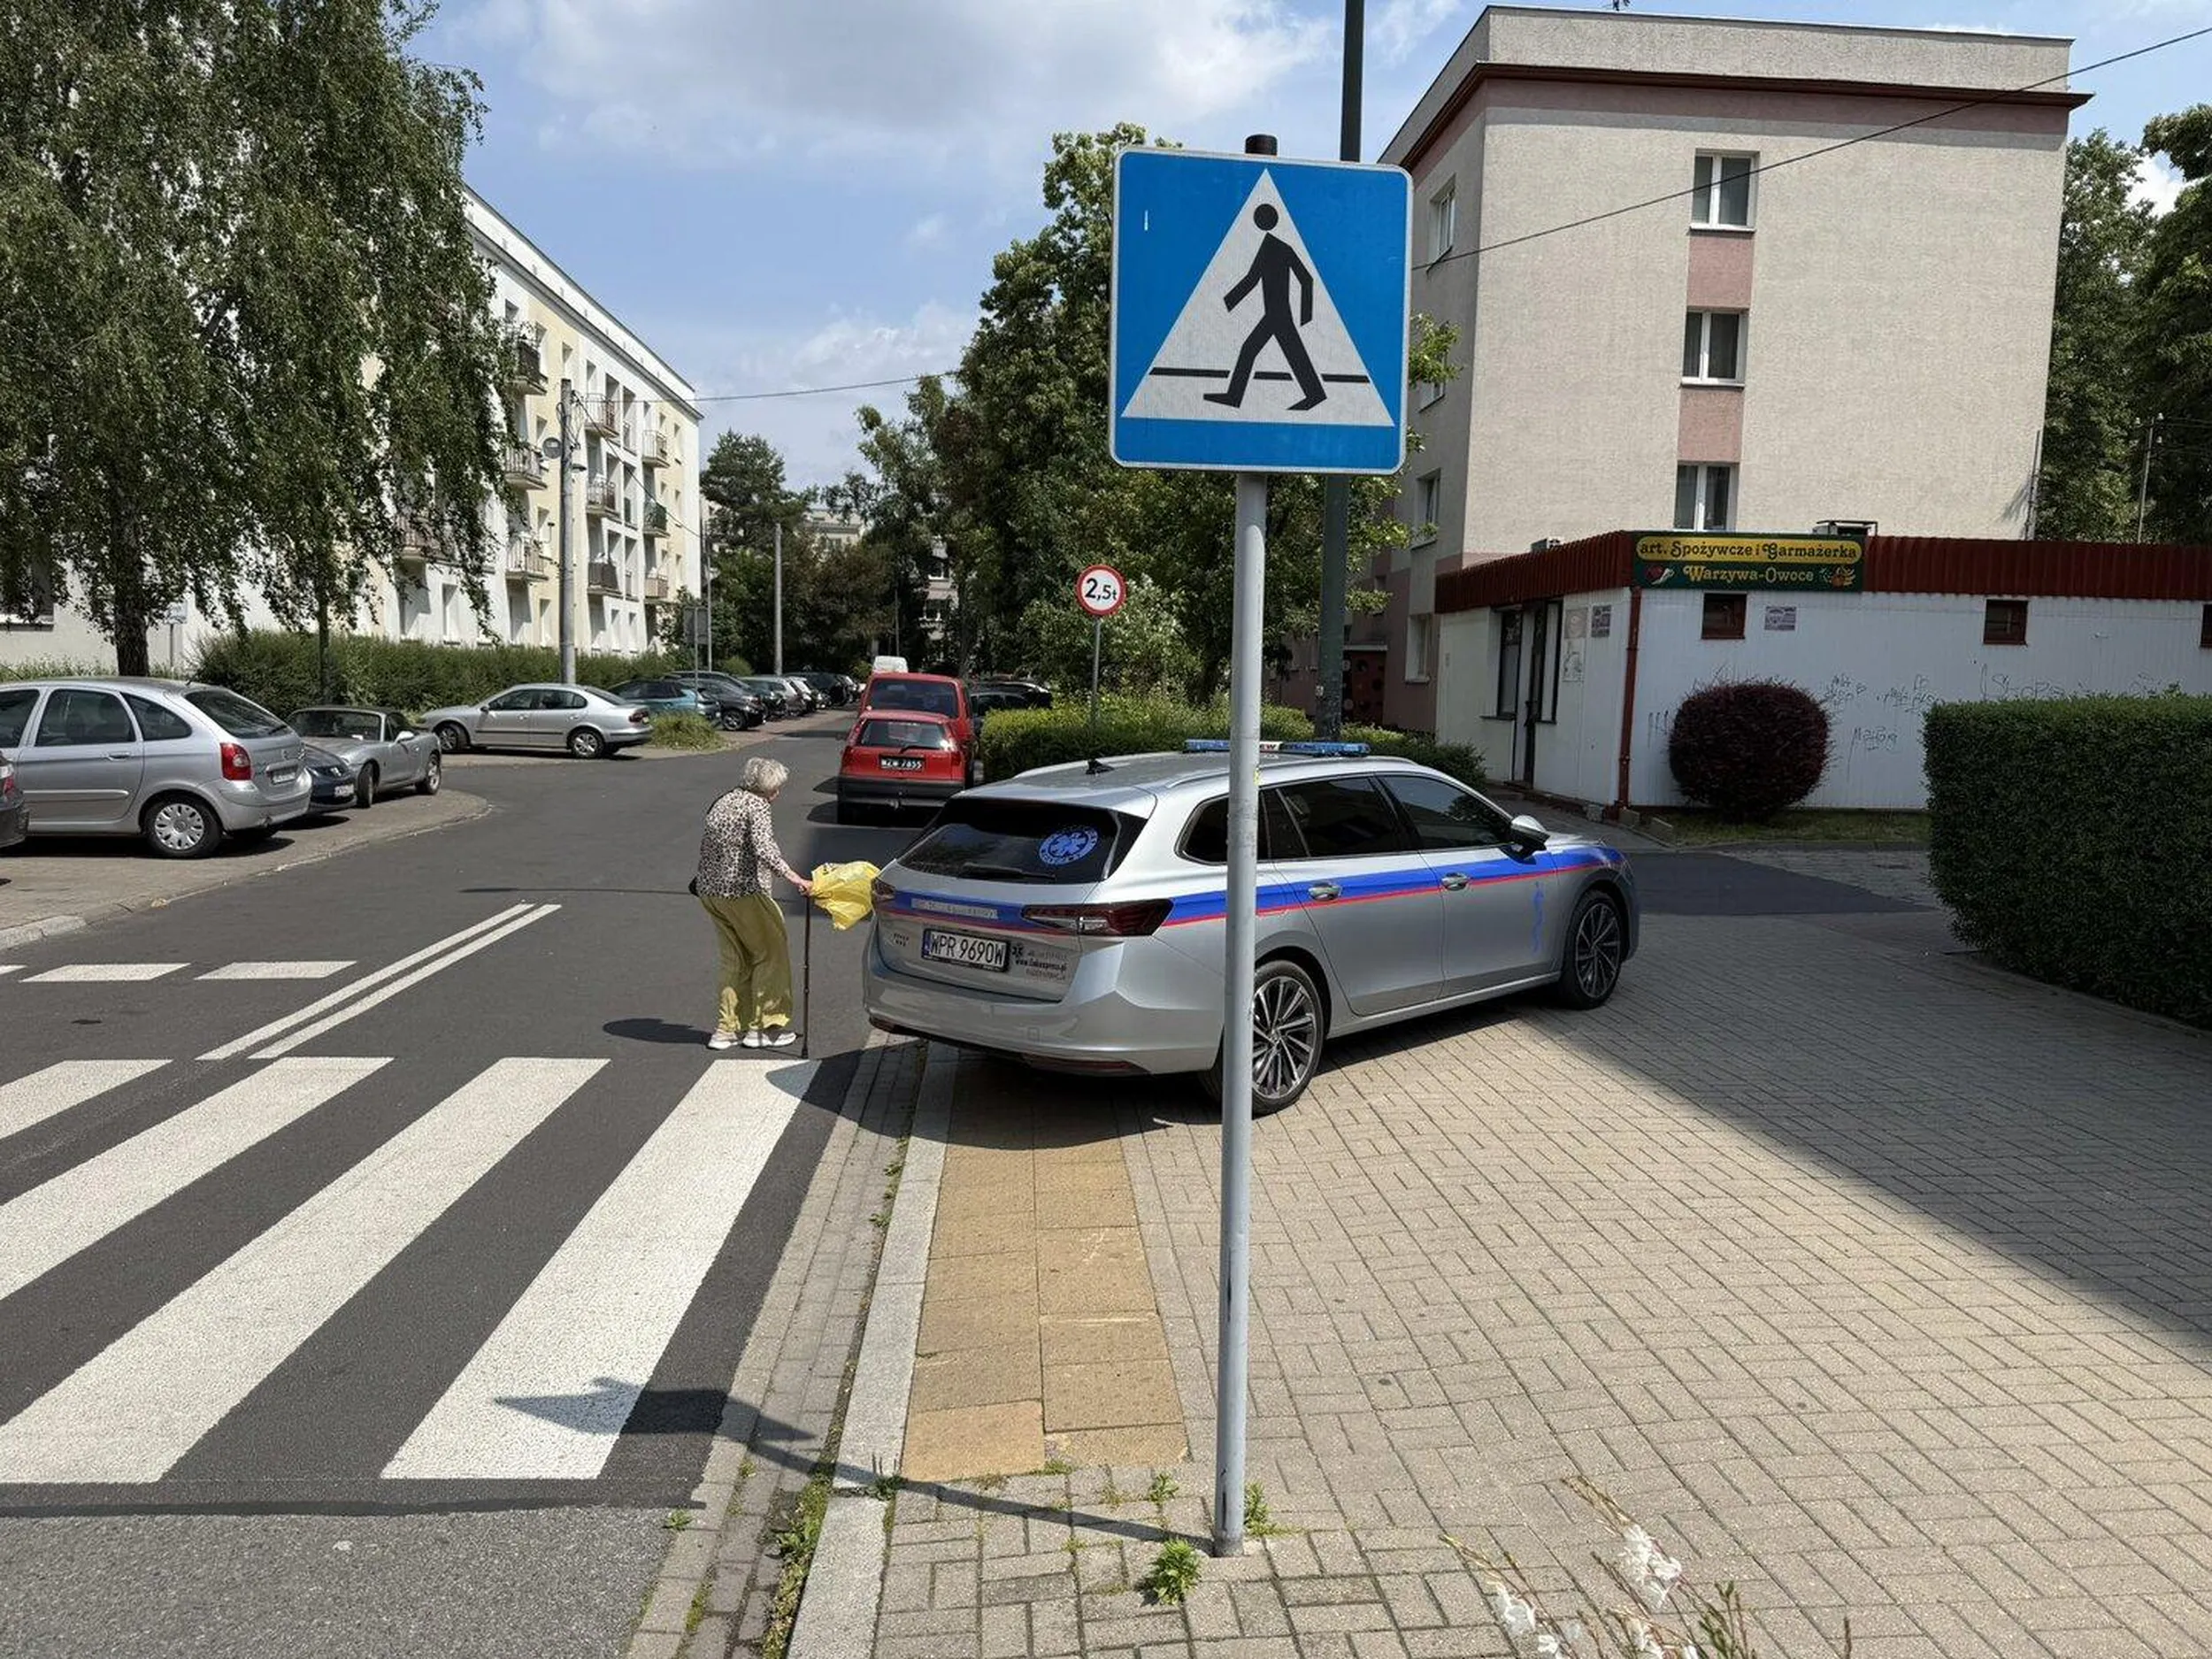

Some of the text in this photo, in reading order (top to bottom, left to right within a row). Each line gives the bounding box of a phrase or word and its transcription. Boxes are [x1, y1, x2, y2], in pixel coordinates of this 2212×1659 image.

[1640, 541, 1667, 555] art.
[1671, 540, 1753, 558] Spożywcze
[1762, 541, 1856, 560] Garmażerka
[1682, 565, 1814, 584] Warzywa-Owoce
[930, 933, 956, 957] WPR
[959, 938, 1006, 965] 9690W
